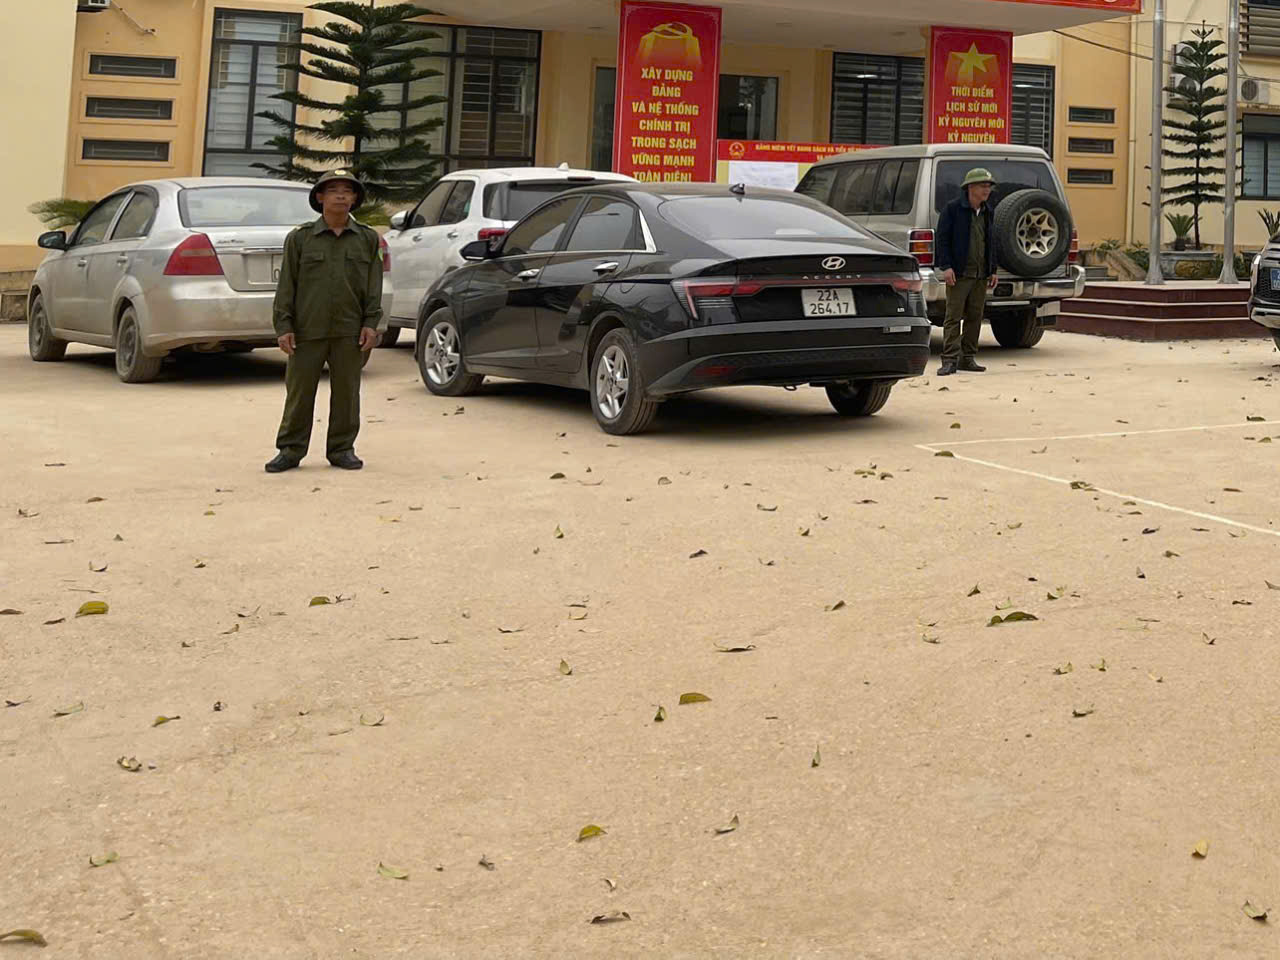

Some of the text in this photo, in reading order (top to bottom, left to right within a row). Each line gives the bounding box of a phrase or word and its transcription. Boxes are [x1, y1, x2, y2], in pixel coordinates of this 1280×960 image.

[641, 66, 693, 82] XÂY DỰNG
[652, 83, 681, 97] ĐẢNG
[632, 100, 699, 116] VÀ HỆ THỐNG
[946, 101, 965, 113] LỊCH
[639, 118, 690, 135] CHÍNH TRỊ
[952, 116, 986, 128] NGUYÊN
[631, 136, 697, 151] TRONG SẠCH
[961, 132, 995, 143] NGUYÊN
[632, 152, 695, 168] VỮNG MẠNH
[816, 290, 839, 301] 22A
[810, 302, 849, 315] 264.17
